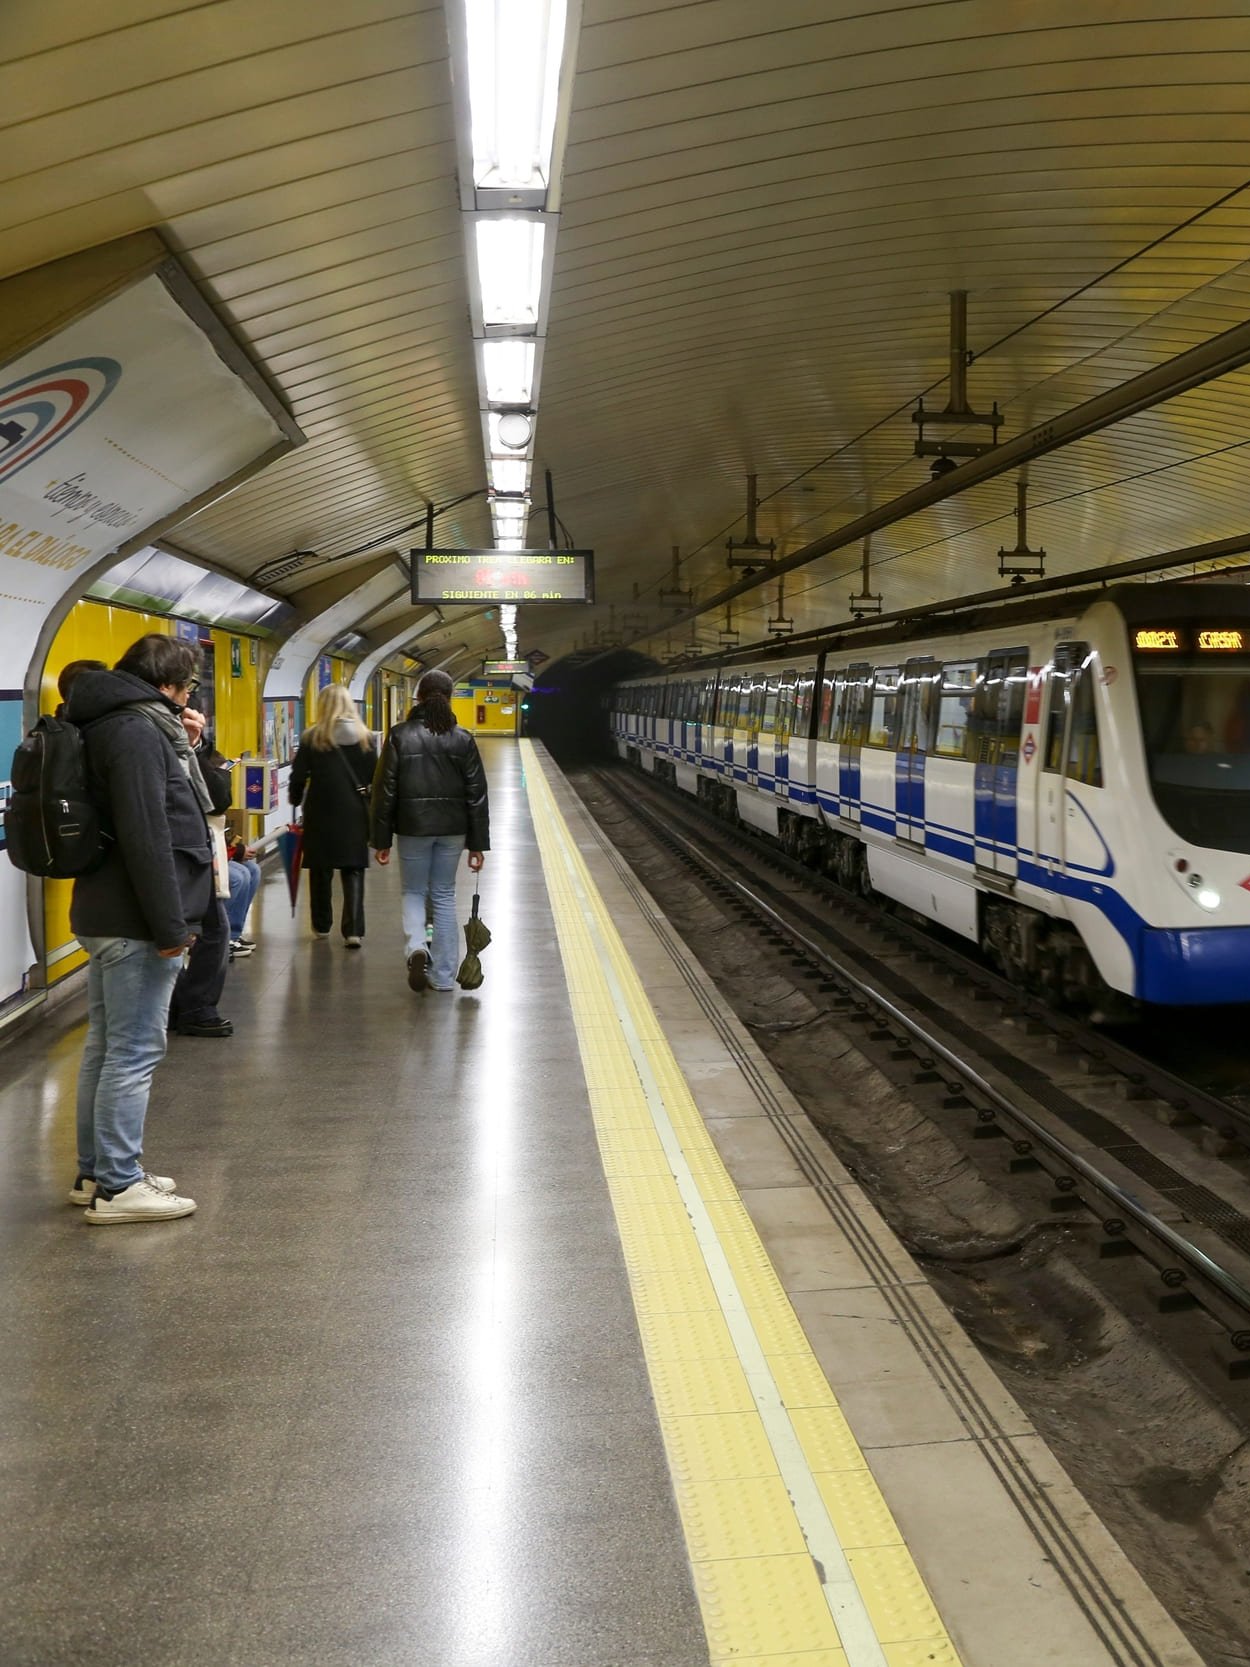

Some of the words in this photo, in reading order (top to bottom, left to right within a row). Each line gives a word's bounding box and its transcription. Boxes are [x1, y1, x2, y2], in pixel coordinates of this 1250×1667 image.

[4, 530, 43, 558] EL
[425, 555, 470, 565] PROXIMO
[442, 591, 499, 600] SIGUIENTE
[505, 591, 518, 600] EN
[542, 591, 561, 600] min
